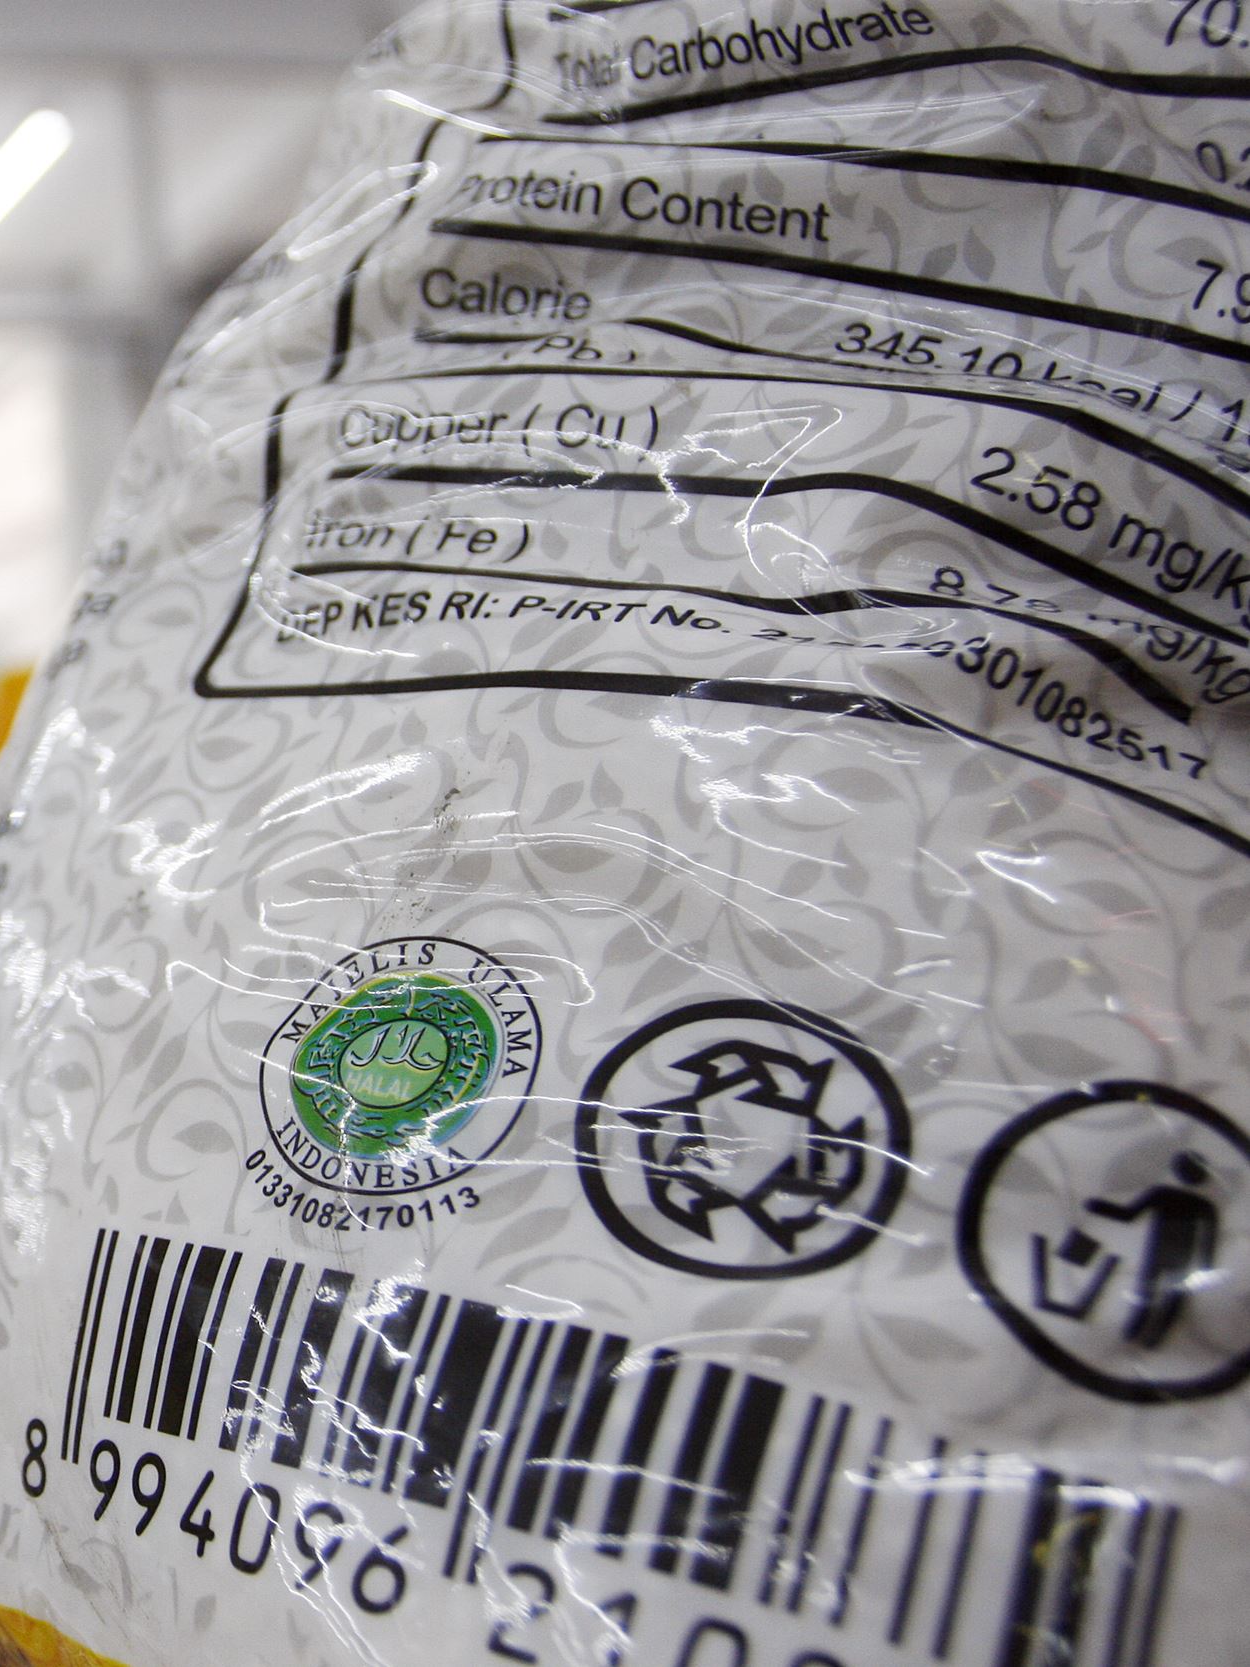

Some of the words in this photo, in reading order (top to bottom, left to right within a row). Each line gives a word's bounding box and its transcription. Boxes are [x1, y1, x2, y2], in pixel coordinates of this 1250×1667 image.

[630, 1, 934, 80] Carbohydrate
[450, 169, 602, 216] Protein
[620, 176, 830, 242] Content
[421, 268, 592, 321] Calorie
[970, 446, 1101, 531] 2.58
[352, 591, 432, 632] KES
[438, 591, 500, 621] RI:
[508, 595, 648, 622] P-IRT
[649, 604, 731, 634] No.
[281, 943, 436, 1044] MAJELIS
[467, 957, 533, 1078] ULAMA
[344, 1071, 415, 1101] HALAL
[244, 1149, 481, 1232] 01331082170113
[275, 1116, 469, 1189] INDONESIA
[22, 1418, 48, 1498] 8
[89, 1438, 410, 1614] 994096
